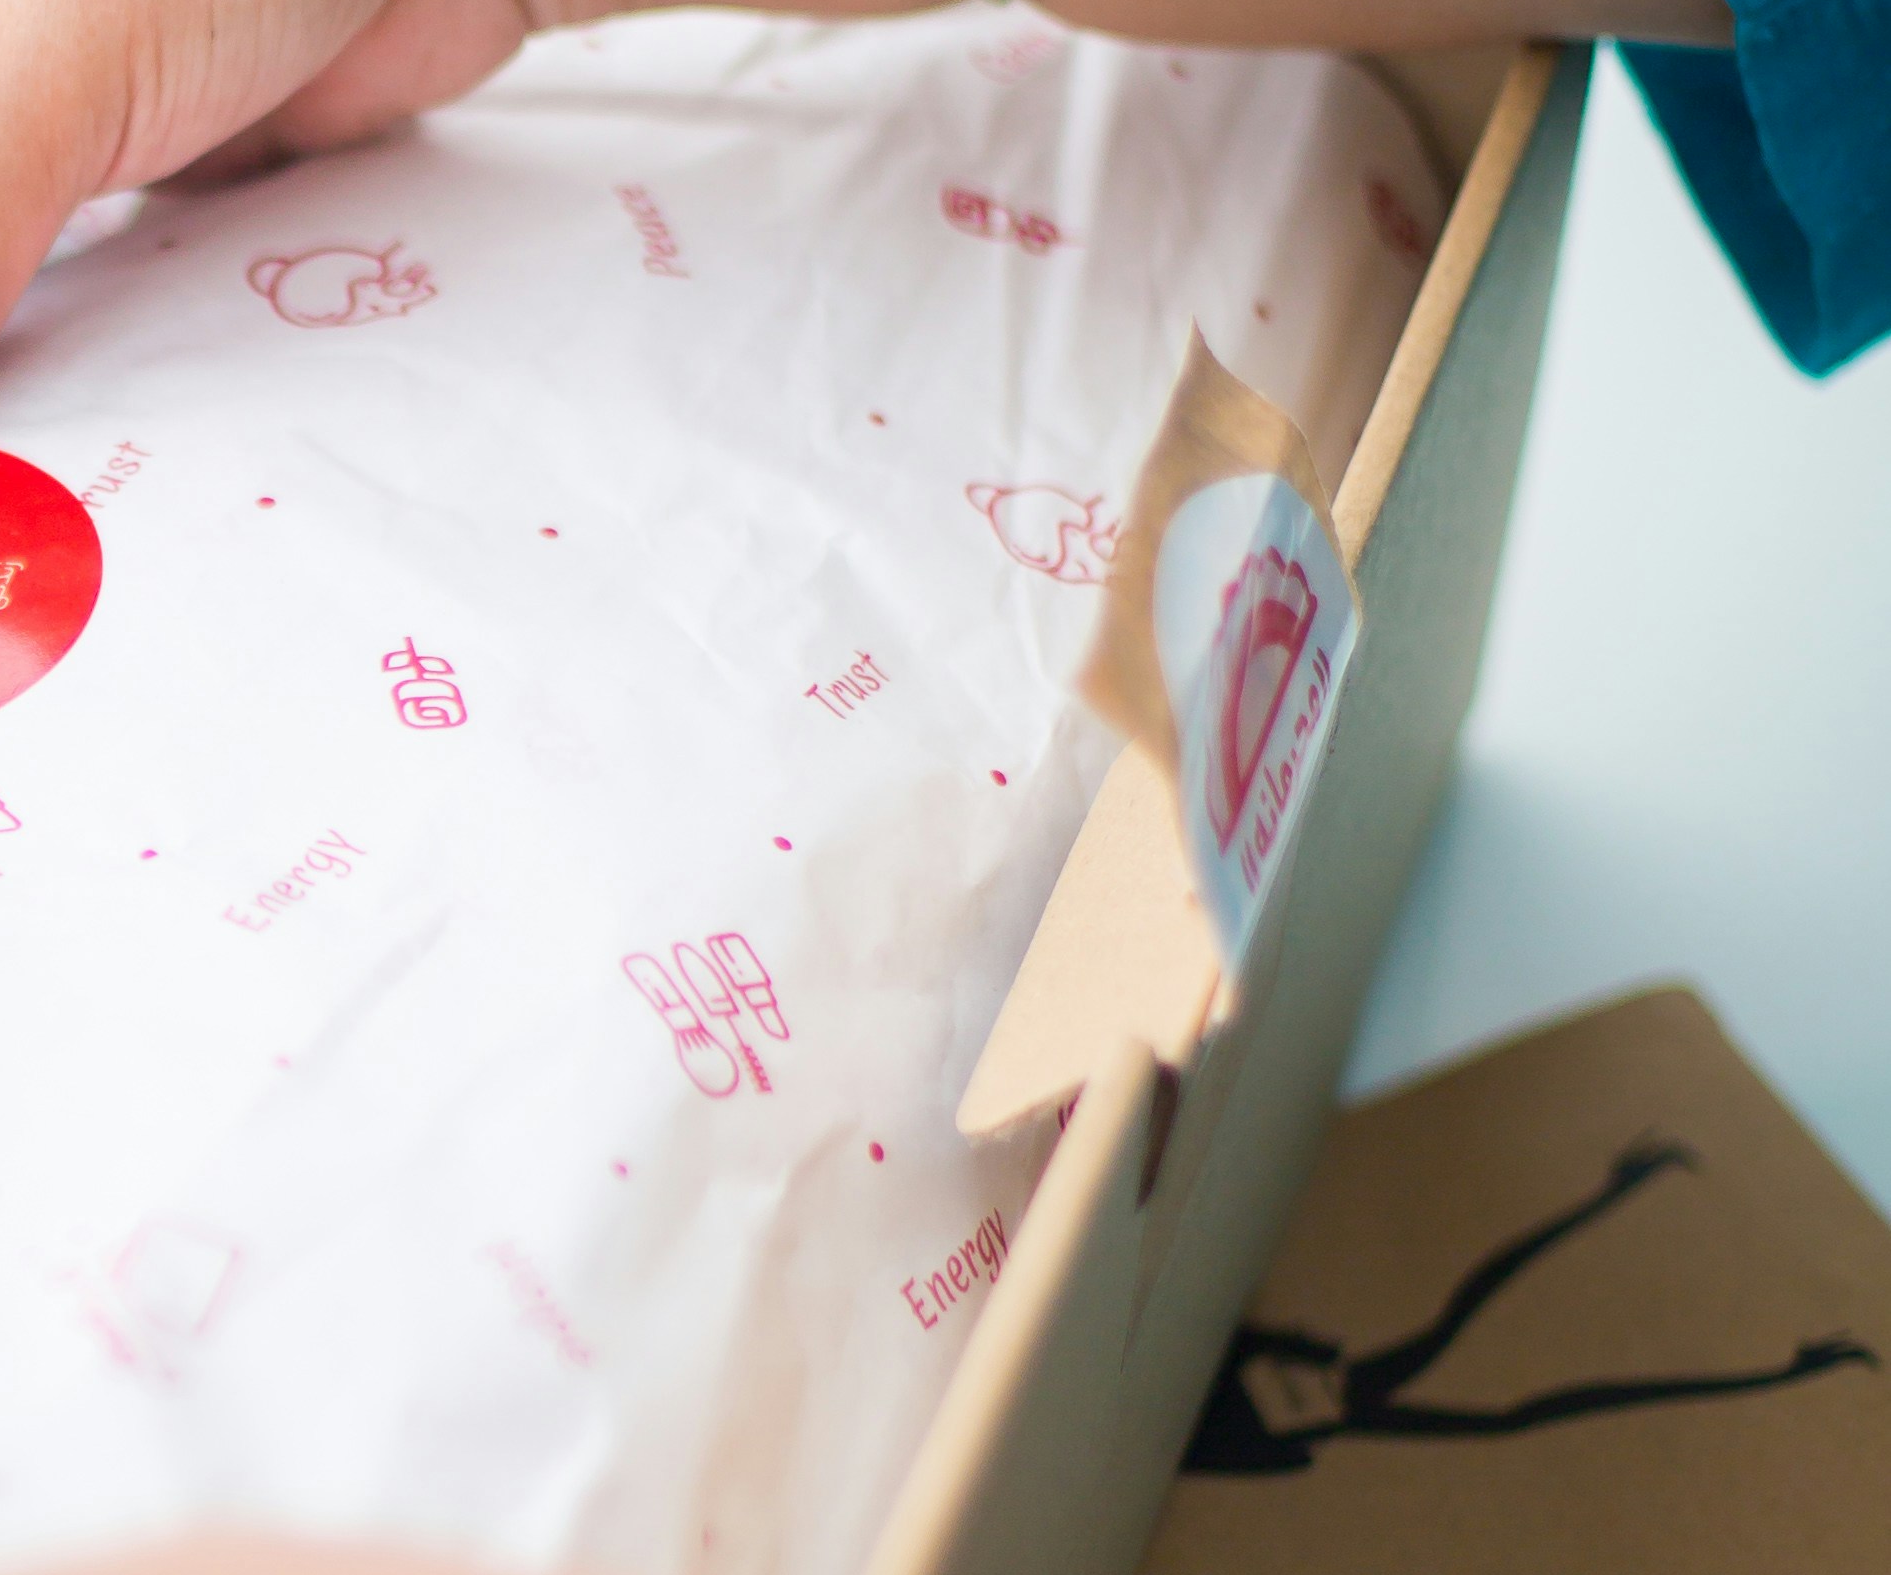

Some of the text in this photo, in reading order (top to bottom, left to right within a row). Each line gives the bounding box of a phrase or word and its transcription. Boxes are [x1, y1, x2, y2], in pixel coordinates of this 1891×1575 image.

[77, 441, 153, 509] rust
[802, 648, 891, 720] Trust
[223, 828, 368, 932] Energy
[900, 1207, 1008, 1330] Energy
